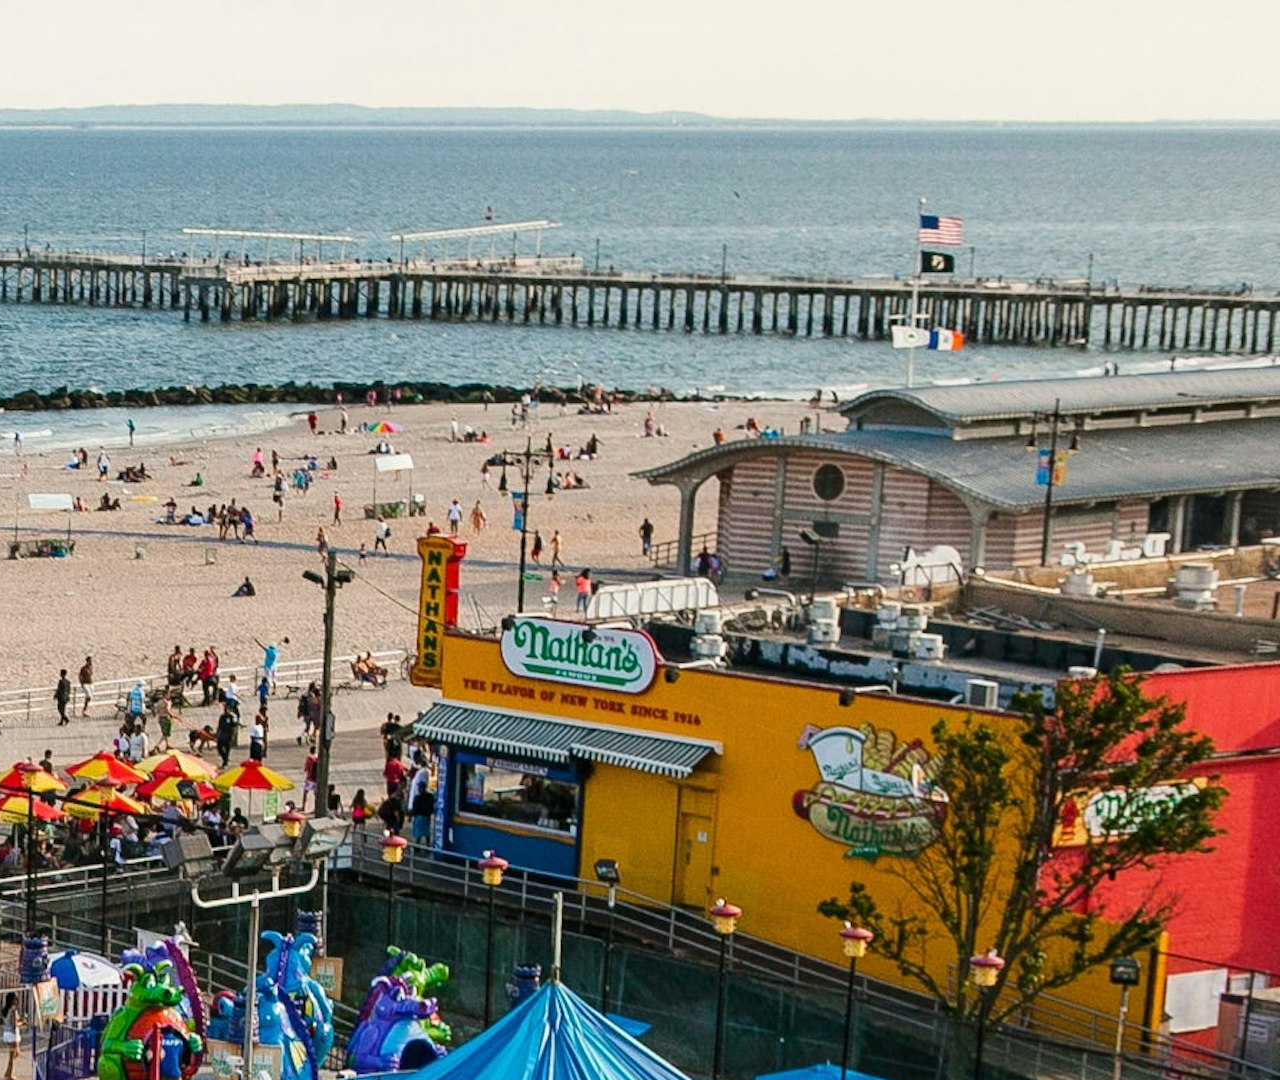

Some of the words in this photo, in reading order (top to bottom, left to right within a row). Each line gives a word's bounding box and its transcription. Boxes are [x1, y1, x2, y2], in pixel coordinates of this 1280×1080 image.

[422, 549, 442, 669] NATHANS
[513, 619, 643, 676] Nathan's
[462, 678, 487, 692] THE
[490, 683, 537, 701] FLAVOR
[541, 690, 557, 702] OF
[561, 694, 587, 709] NEW
[594, 698, 626, 716] YORK
[631, 705, 671, 722] SINCE
[674, 711, 701, 726] 1916
